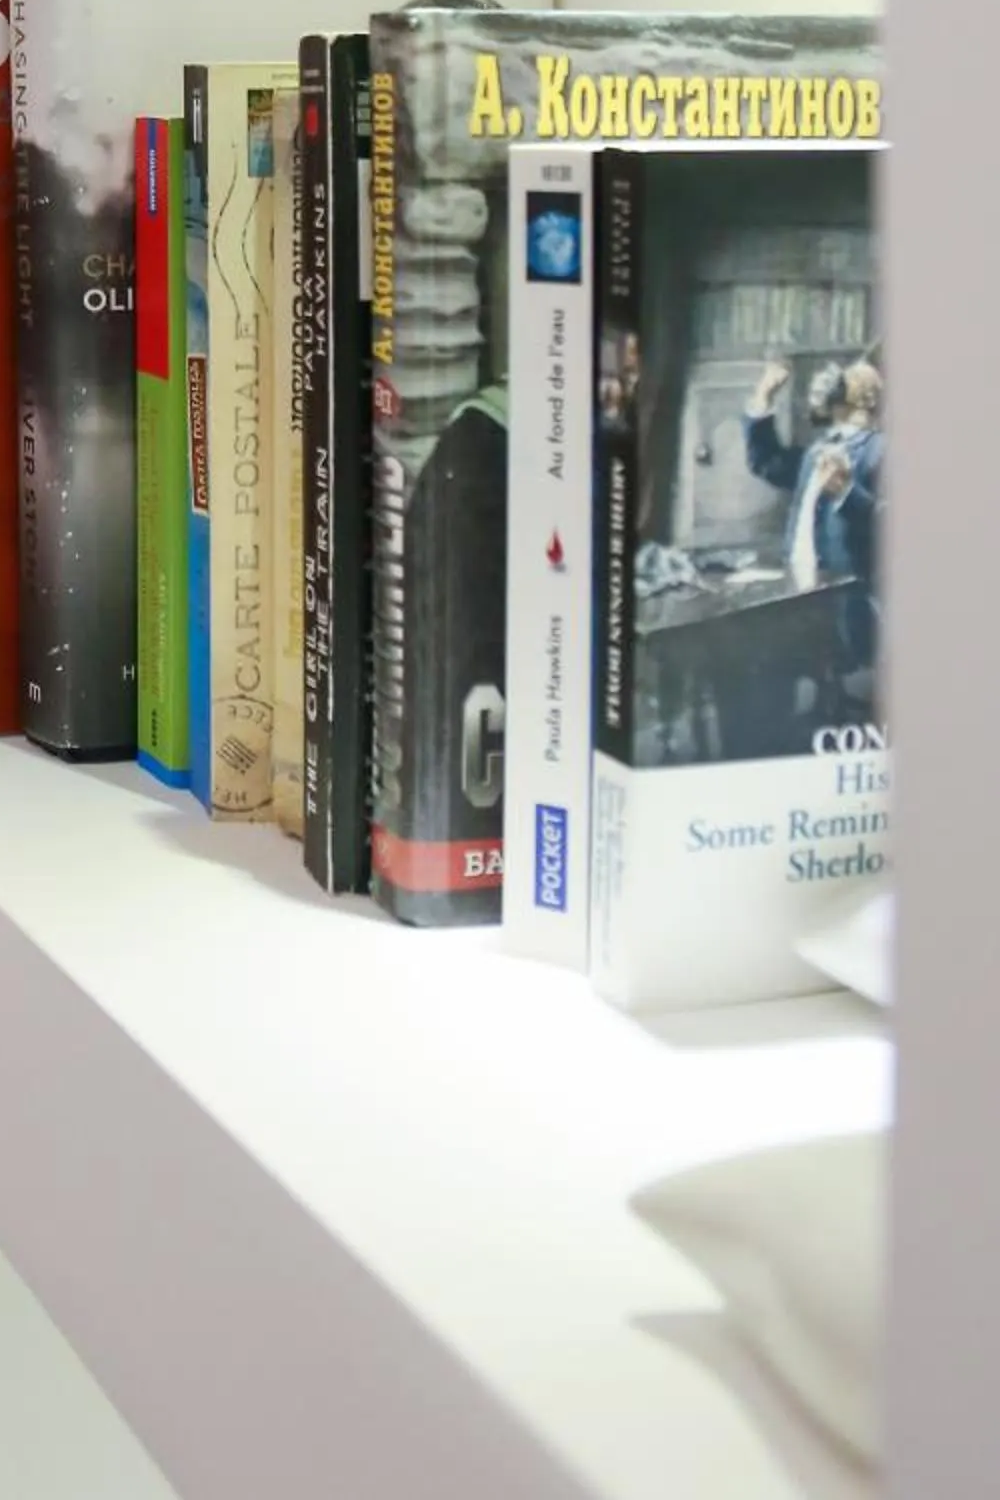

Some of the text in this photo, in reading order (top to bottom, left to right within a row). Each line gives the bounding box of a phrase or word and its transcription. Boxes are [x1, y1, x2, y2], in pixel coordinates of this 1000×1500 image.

[469, 55, 522, 137] А.
[16, 224, 33, 327] LIGHT
[83, 254, 135, 278] CH
[303, 184, 325, 391] PAULA HAWKINS
[547, 364, 565, 390] de
[546, 398, 565, 445] fond
[234, 312, 262, 692] CARTE POSTALE
[549, 452, 565, 480] Au
[316, 449, 329, 681] THE TRAIN
[306, 626, 317, 722] GIRL
[545, 615, 563, 762] Paula Hawkins
[306, 742, 318, 813] THE
[687, 818, 774, 853] Some
